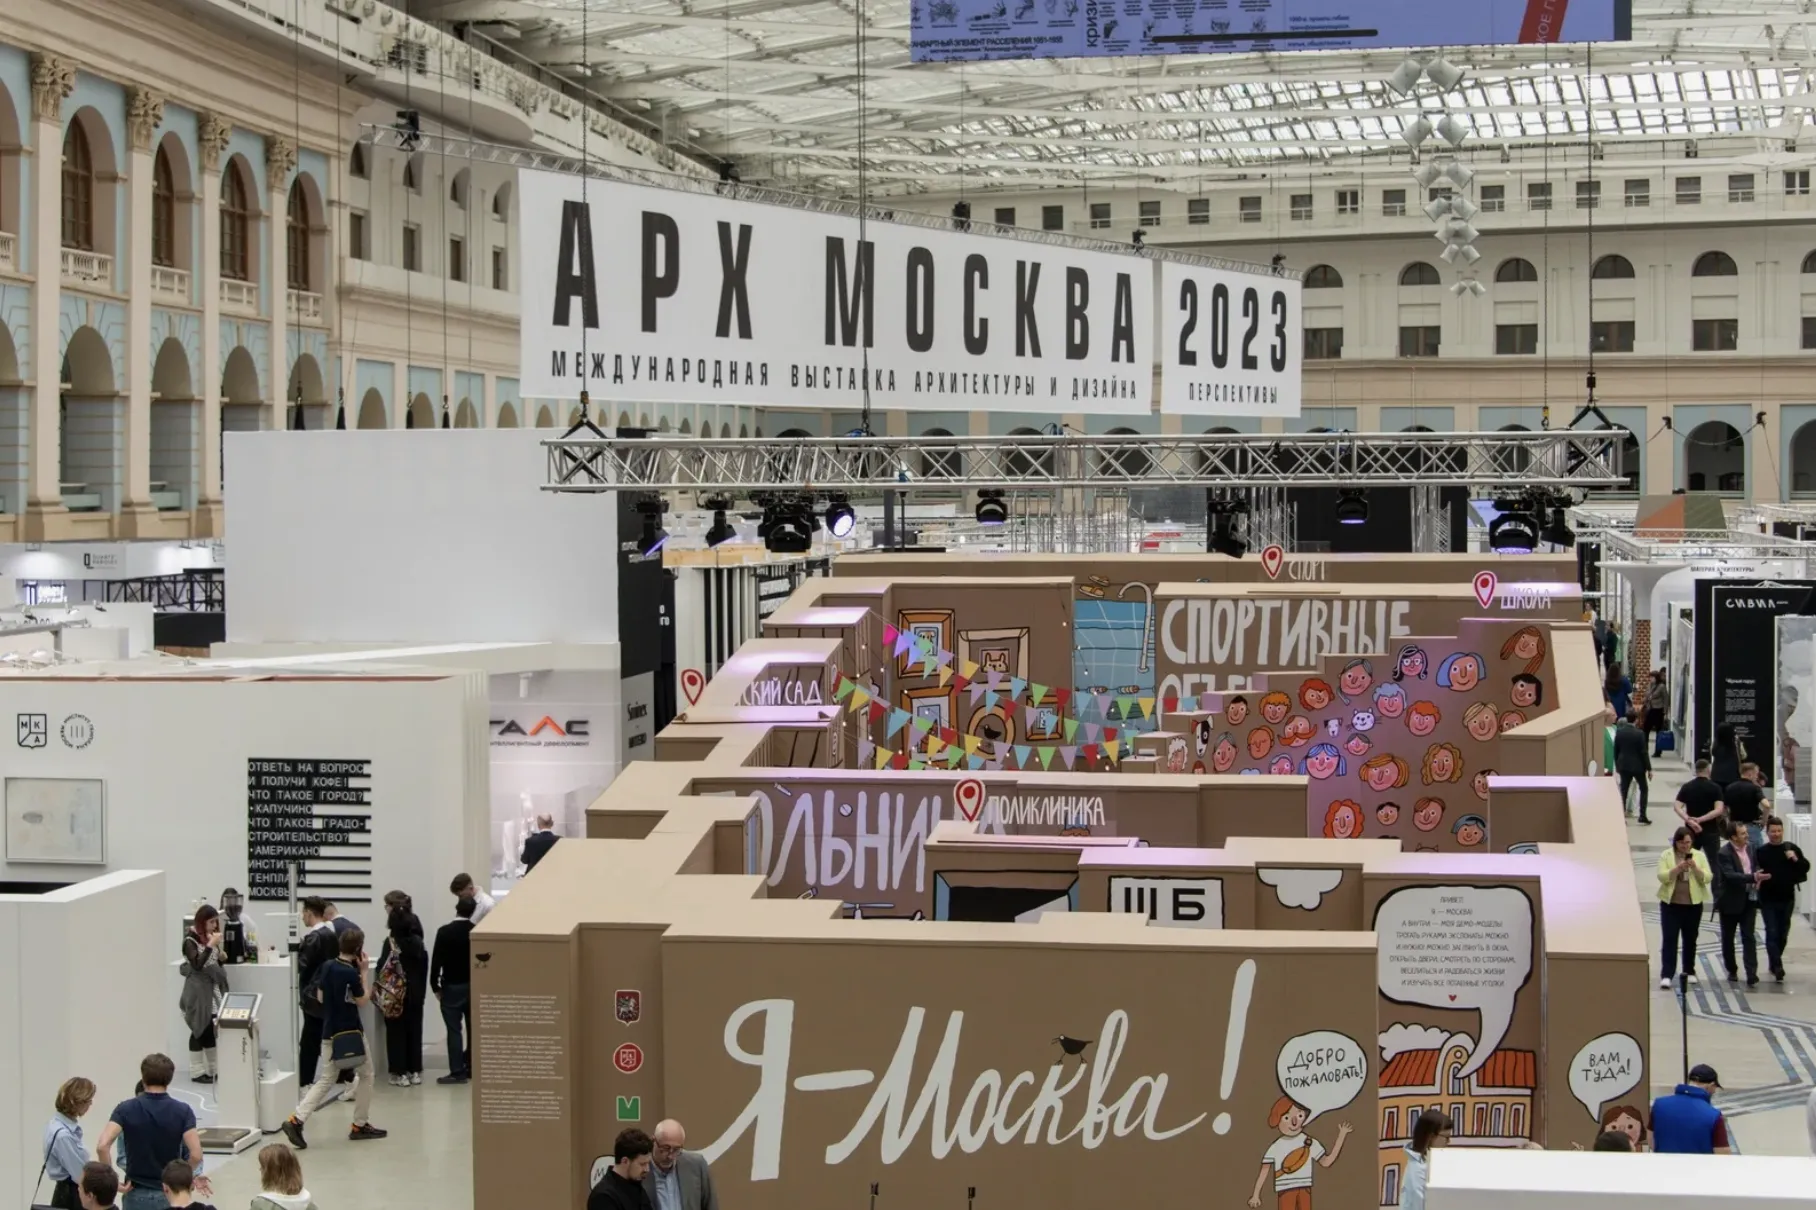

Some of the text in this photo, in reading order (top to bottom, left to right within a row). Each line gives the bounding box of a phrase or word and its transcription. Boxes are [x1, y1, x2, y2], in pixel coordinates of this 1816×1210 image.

[552, 200, 1136, 363] АРХ МОСКВА
[1178, 278, 1287, 373] 2023
[552, 351, 768, 389] МЕЖДУНАРОДНАЯ
[914, 370, 1035, 397] АРХИТЕКТУРЫ
[1050, 376, 1057, 396] И
[1072, 375, 1137, 401] ДИЗАЙНА
[1189, 382, 1278, 405] ПЕРСПЕКТИВЫ
[1289, 560, 1325, 581] СПОРТ
[1500, 588, 1551, 609] ШКОЛА
[1725, 598, 1776, 609] СИВИЛ
[785, 679, 822, 706] САД
[249, 762, 364, 773] ОТВЕТЬ НА ВОПРОС
[249, 776, 348, 787] И ПОЛУЧИ КОФЕ!
[249, 790, 364, 801] ЧТО ТАКОЕ ГОРОД?
[988, 795, 1105, 826] ПОЛИКЛИНИКА
[249, 818, 364, 829] ЧТО ТАКОЕ ГРАДО-
[249, 831, 349, 842] СТРОИТЕЛЬСТВО?
[249, 873, 306, 883] ГЕНПЛАА
[1287, 1047, 1346, 1073] ДОБРО
[1589, 1052, 1621, 1067] ВАМ
[1285, 1056, 1364, 1089] ПОЖАЛОВАТЬ!
[1582, 1061, 1632, 1083] ТУДА!
